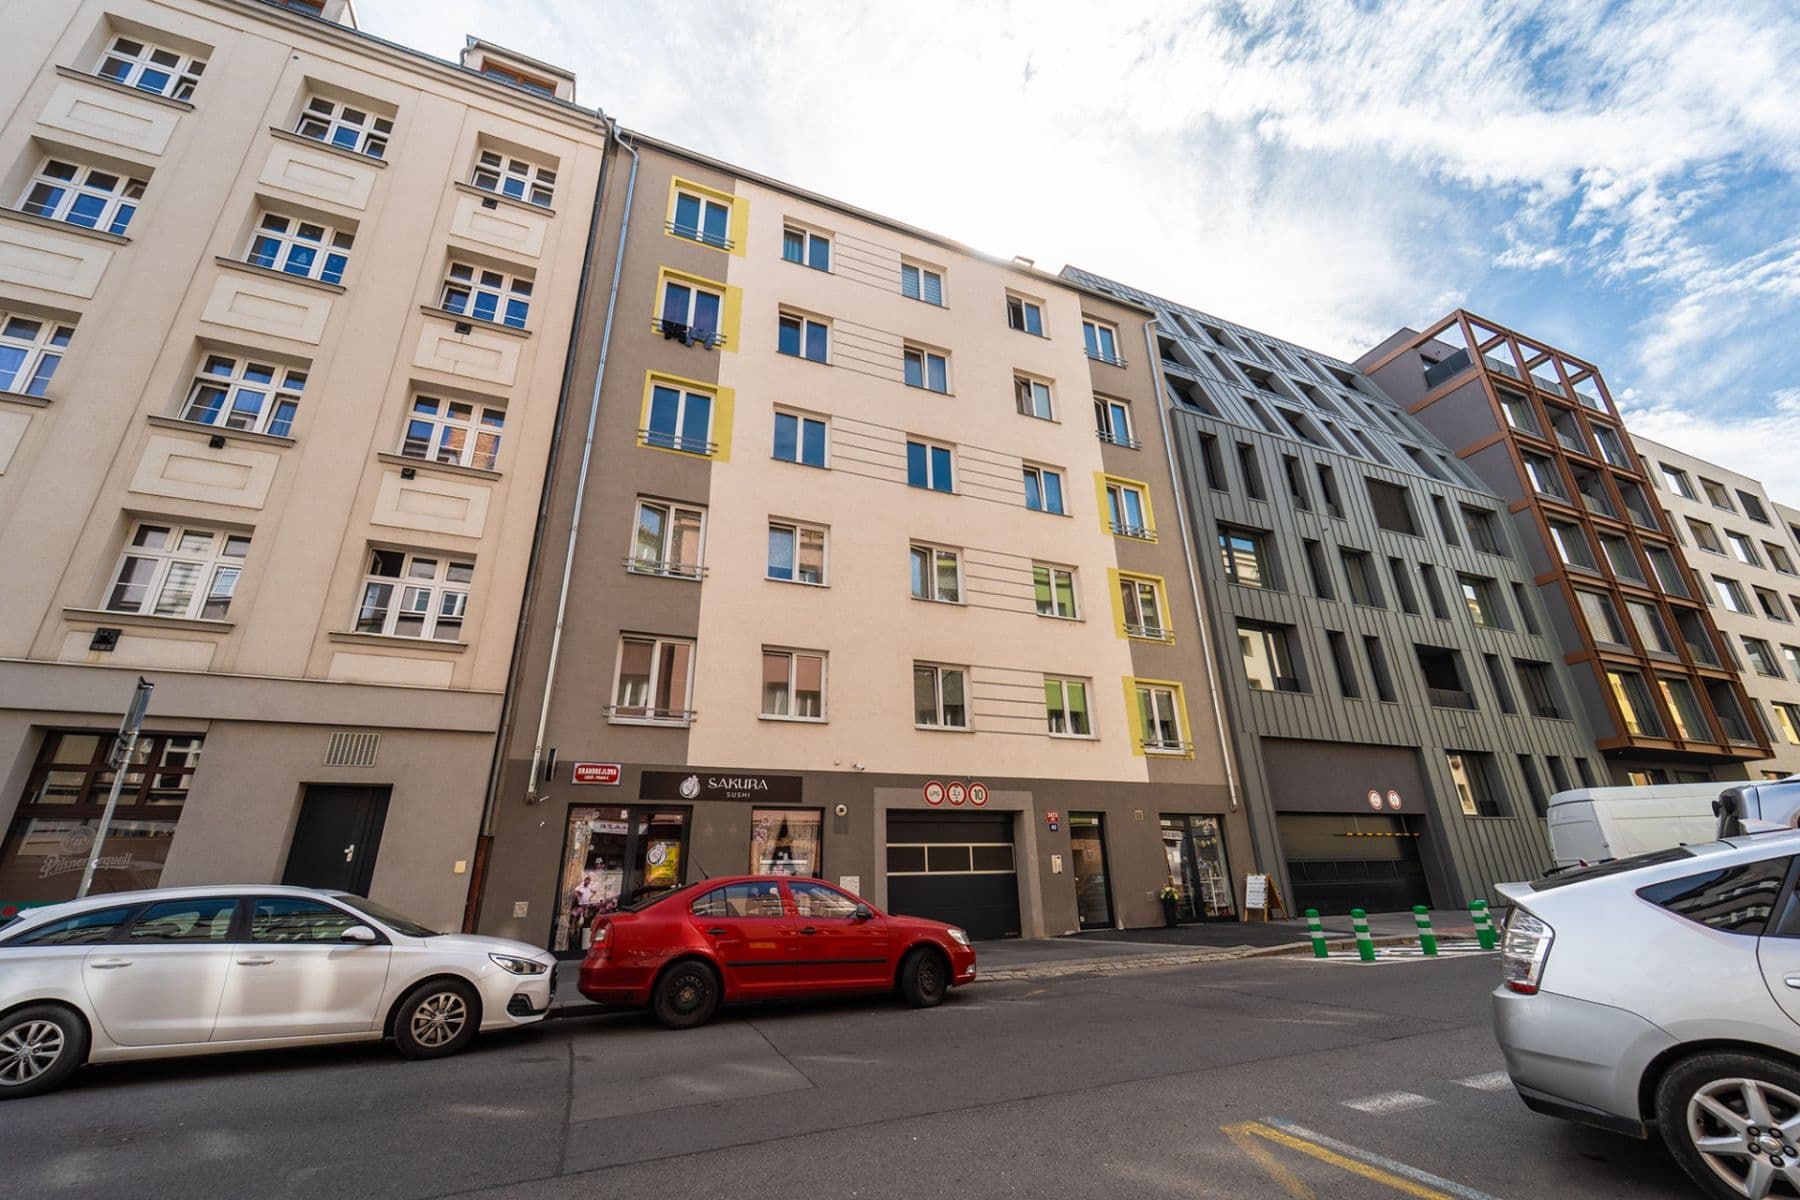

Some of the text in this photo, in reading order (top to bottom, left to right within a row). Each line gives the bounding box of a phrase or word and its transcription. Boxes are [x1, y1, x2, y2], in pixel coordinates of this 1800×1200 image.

[708, 777, 768, 790] SAKURA
[974, 789, 983, 800] 10
[40, 854, 88, 879] Pilsner
